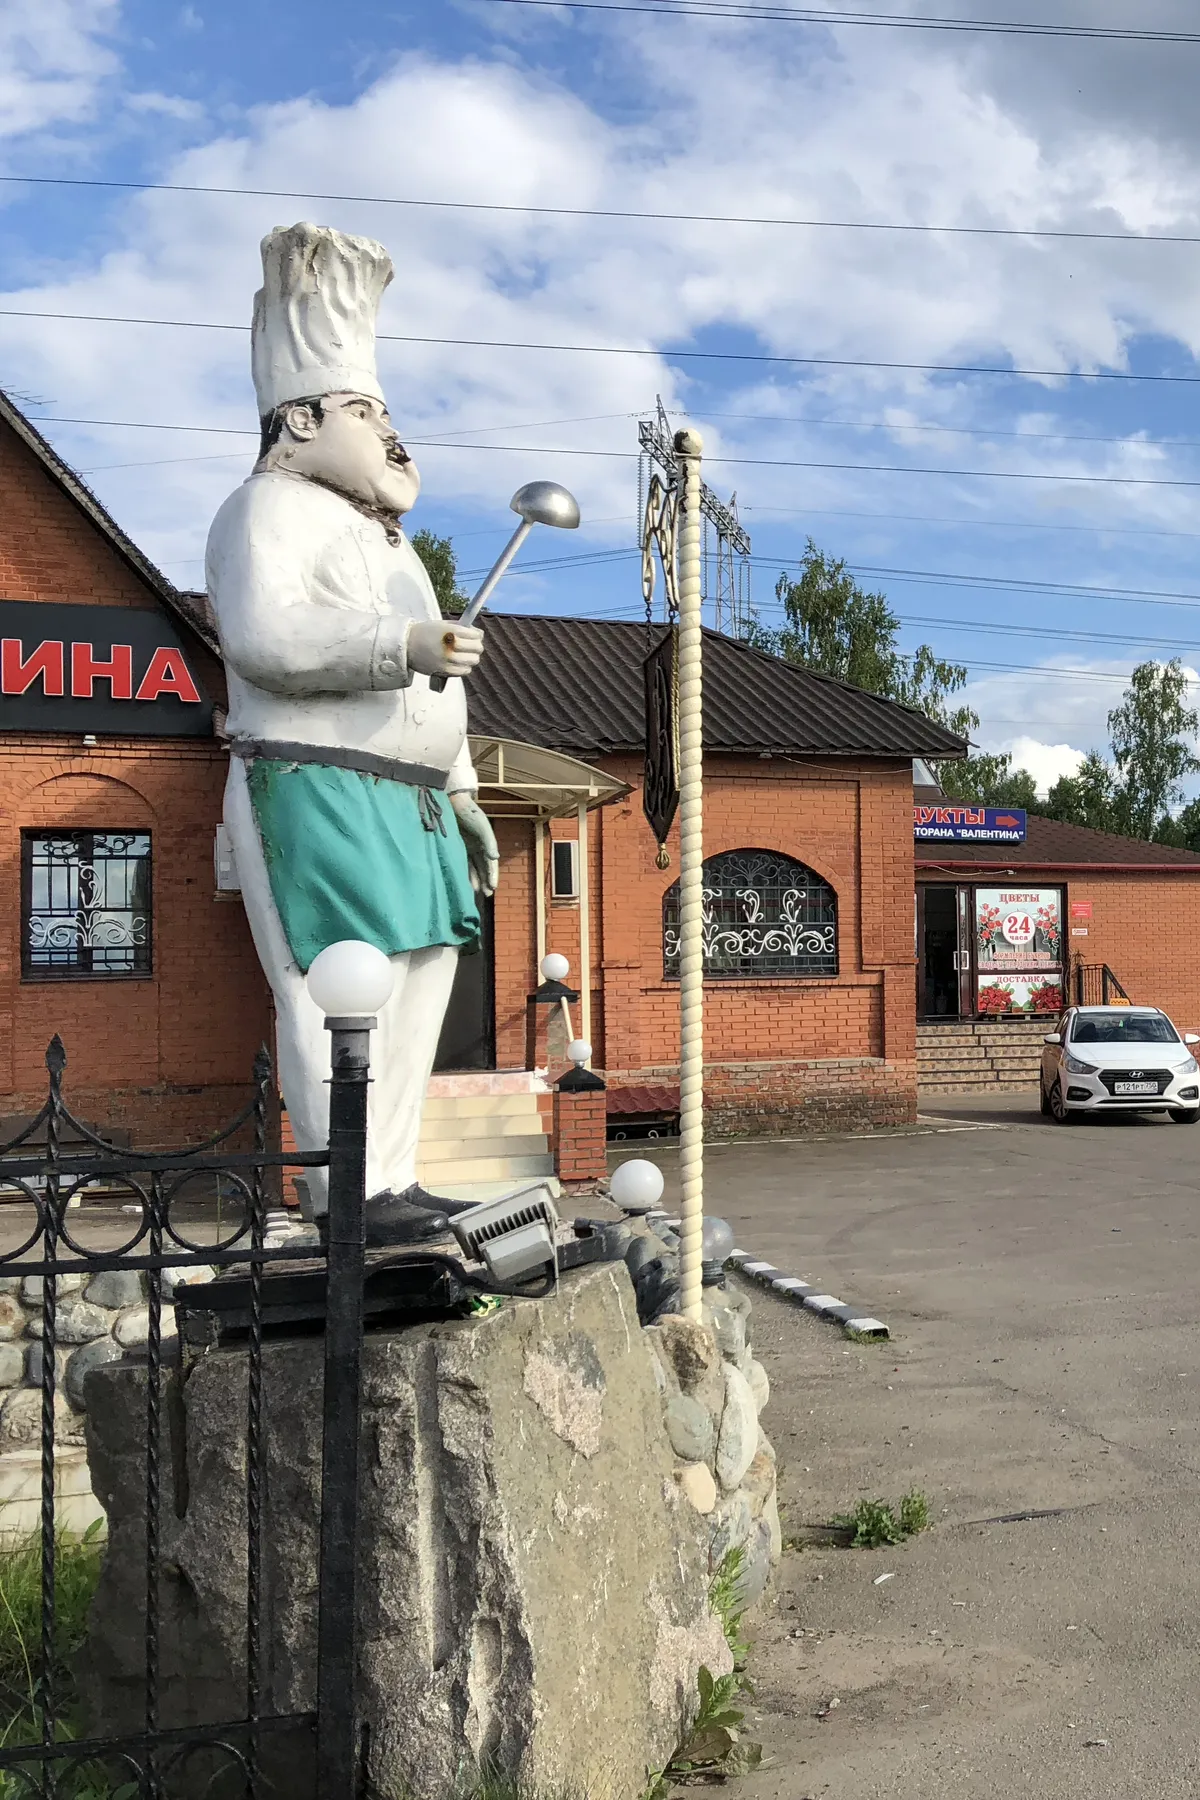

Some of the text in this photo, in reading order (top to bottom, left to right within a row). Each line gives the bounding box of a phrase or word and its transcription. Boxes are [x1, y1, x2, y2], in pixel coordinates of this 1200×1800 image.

[1, 638, 201, 702] ИНА
[913, 827, 954, 837] ТОРАНА
[999, 893, 1040, 904] ЦВЕТЫ
[1007, 916, 1031, 934] 24
[996, 976, 1047, 984] ДОСТАВКА
